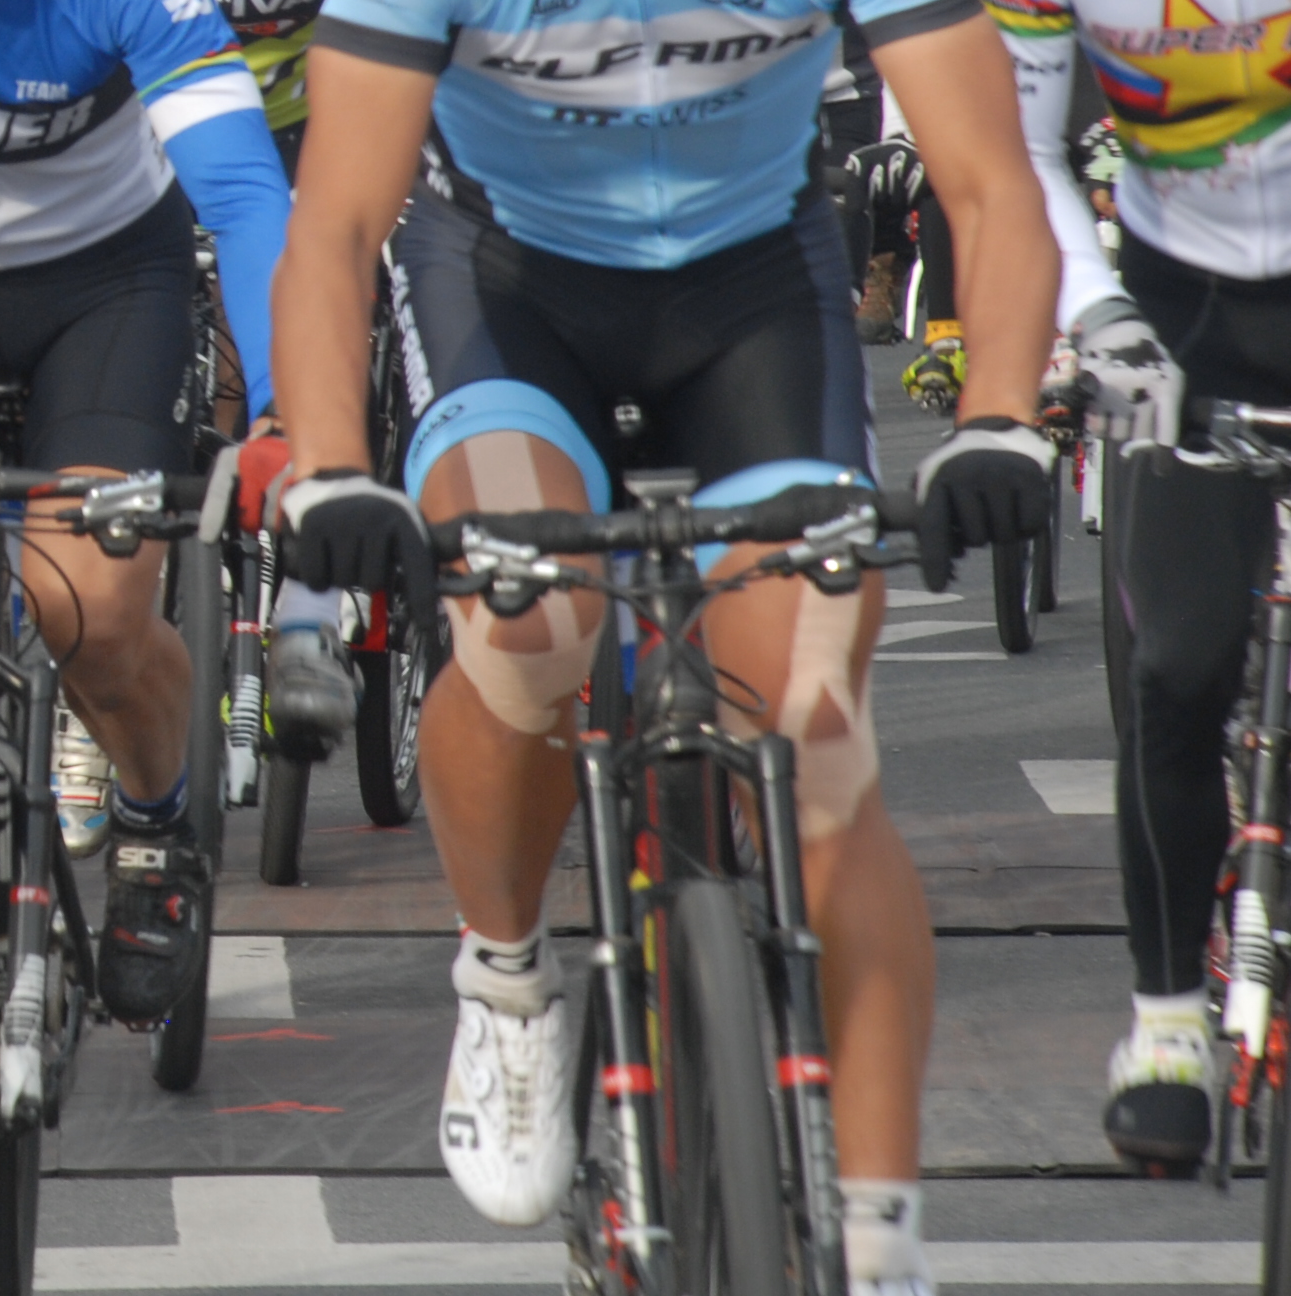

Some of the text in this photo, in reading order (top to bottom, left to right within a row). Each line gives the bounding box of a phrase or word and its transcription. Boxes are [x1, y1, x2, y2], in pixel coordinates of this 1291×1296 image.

[481, 24, 817, 81] ELFAMA
[16, 80, 69, 103] TEAM
[116, 846, 167, 870] SIDI
